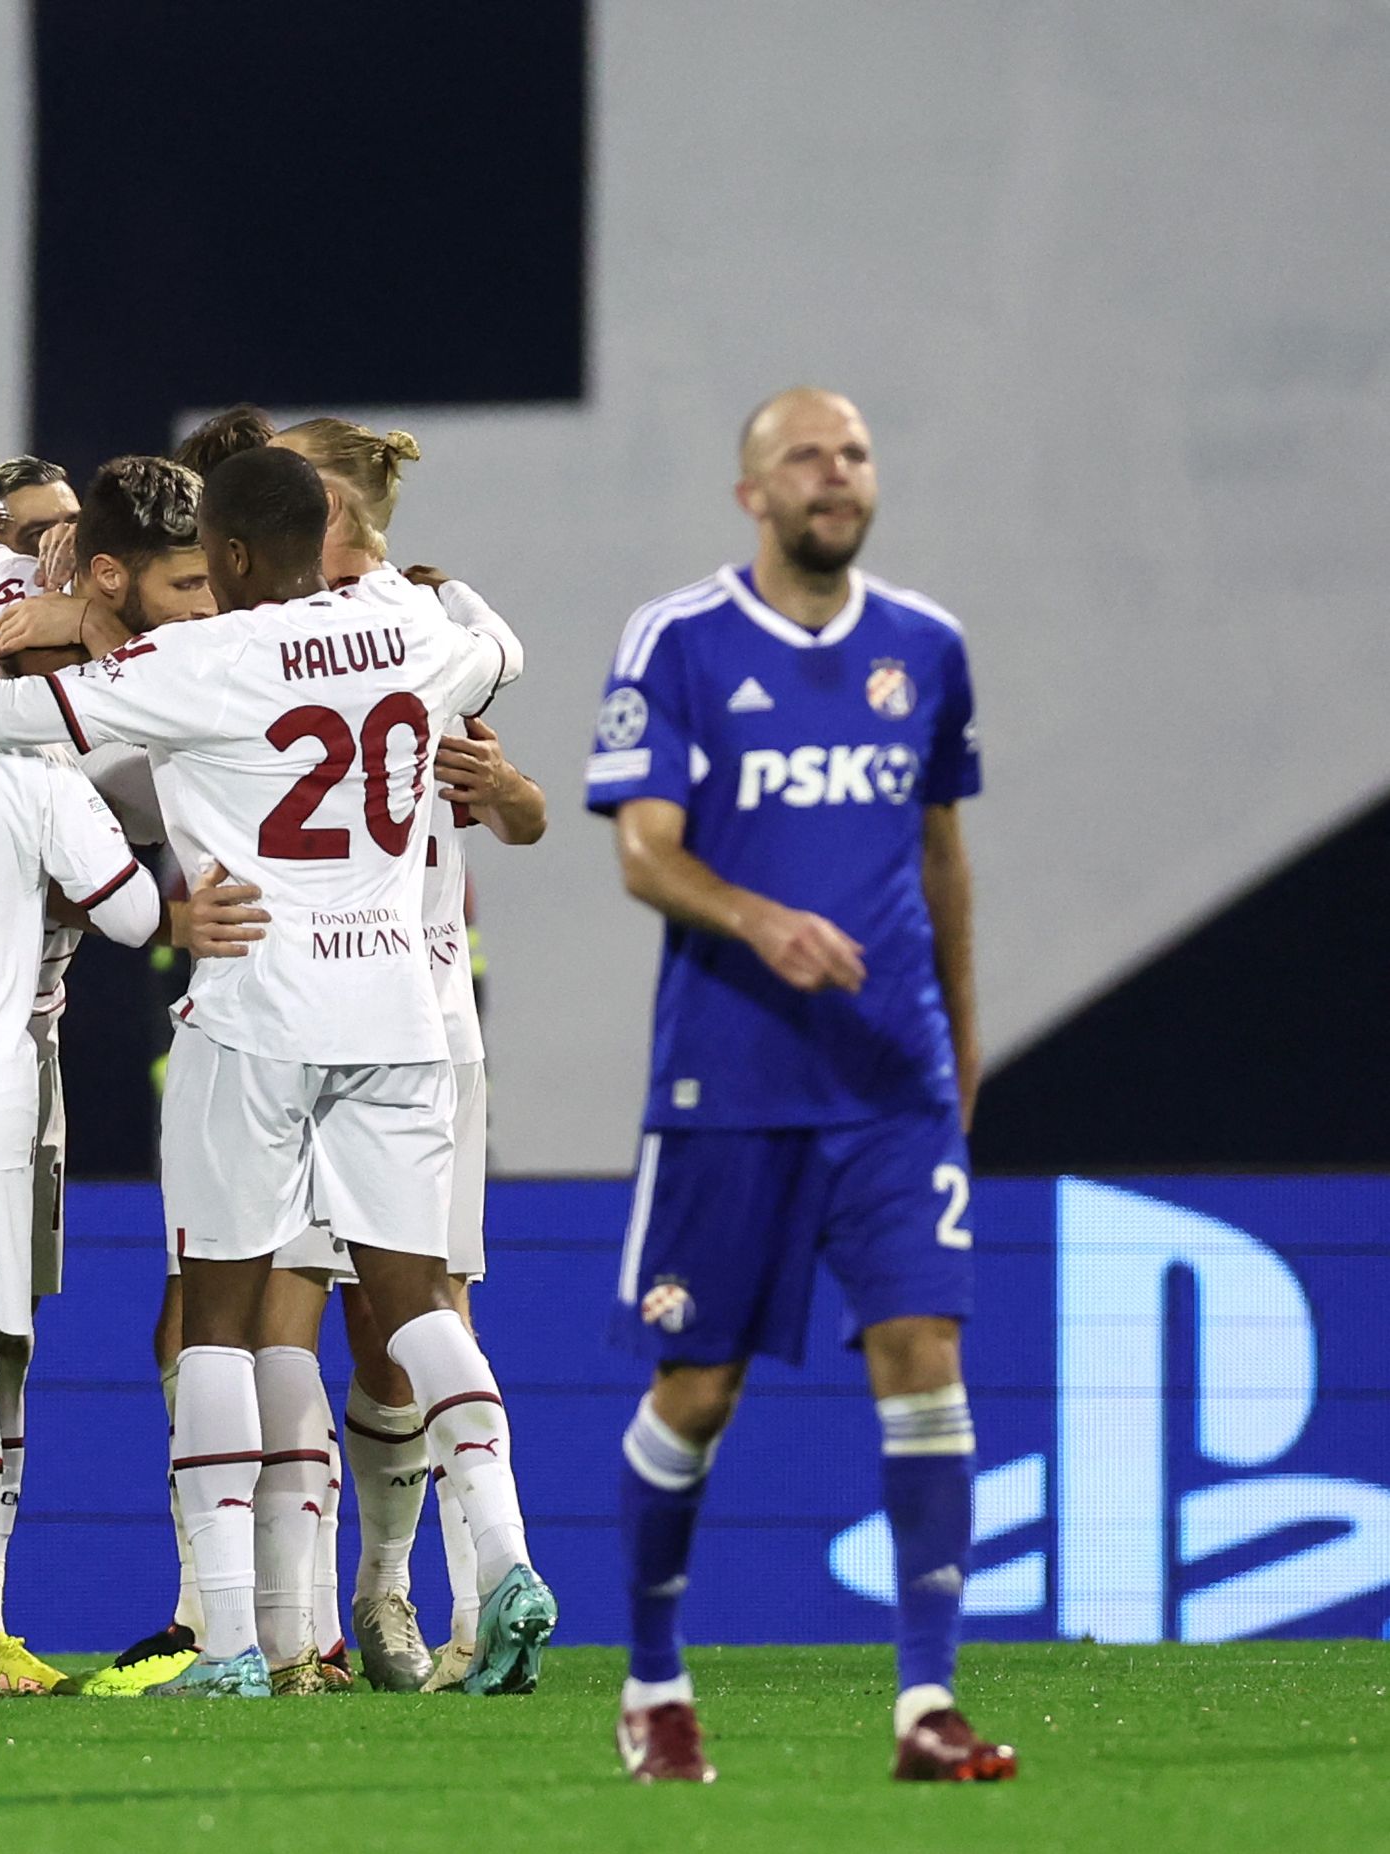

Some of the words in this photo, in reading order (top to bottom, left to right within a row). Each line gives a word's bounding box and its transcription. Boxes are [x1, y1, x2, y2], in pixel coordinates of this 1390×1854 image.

[280, 627, 406, 681] KALULU
[258, 692, 430, 859] 20
[736, 744, 878, 811] PSK
[311, 907, 403, 927] FONDAZIOE
[312, 928, 412, 960] MILAN
[932, 1163, 974, 1251] 2
